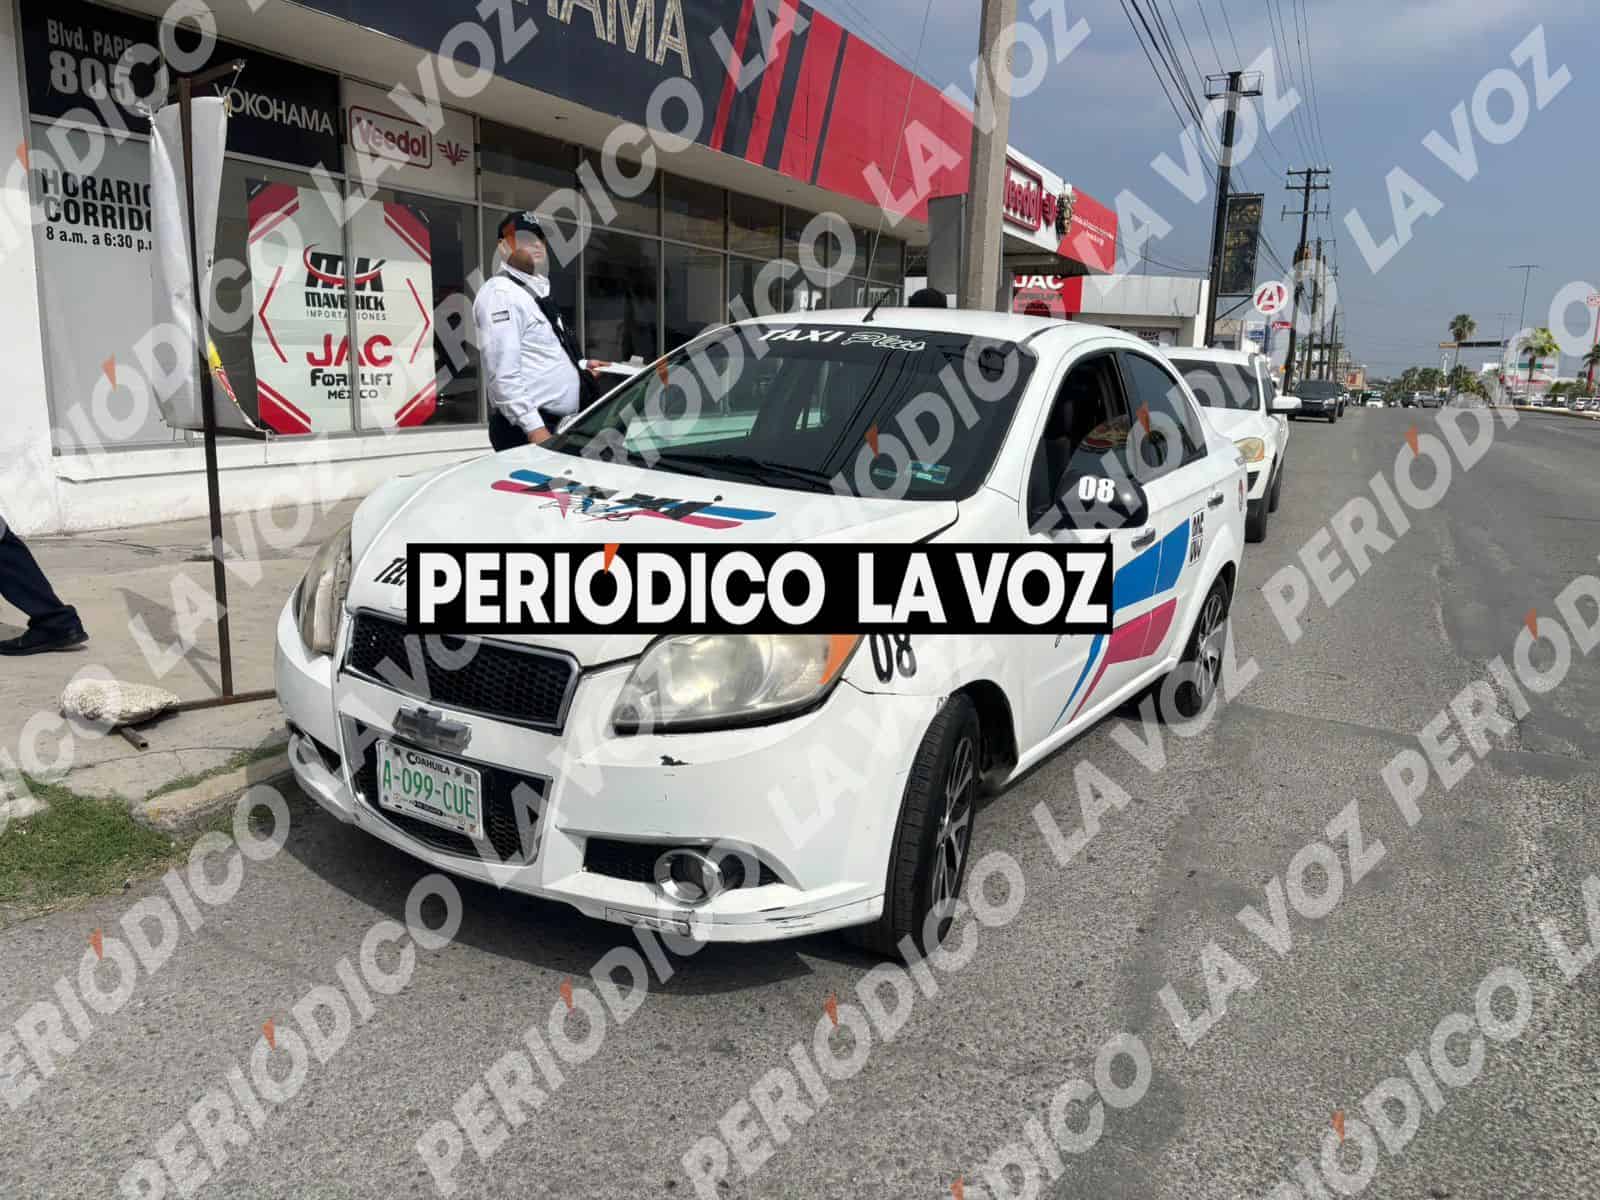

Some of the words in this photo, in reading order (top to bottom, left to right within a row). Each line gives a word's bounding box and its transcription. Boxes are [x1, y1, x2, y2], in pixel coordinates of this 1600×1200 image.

[47, 19, 89, 53] Blvd.
[214, 83, 334, 136] YOKOHAMA
[355, 116, 427, 158] Veedol
[46, 226, 55, 241] 8
[59, 231, 88, 245] a.m.
[91, 234, 101, 246] a
[103, 233, 132, 249] 6:30
[137, 239, 151, 253] p.
[305, 291, 385, 312] MAVEICK
[306, 310, 387, 321] IMPORTAIONES
[758, 329, 846, 343] TAXI
[306, 333, 393, 368] JAC
[310, 368, 393, 387] FORLIFT
[1078, 475, 1115, 503] 08
[383, 759, 477, 819] A-099-CUE
